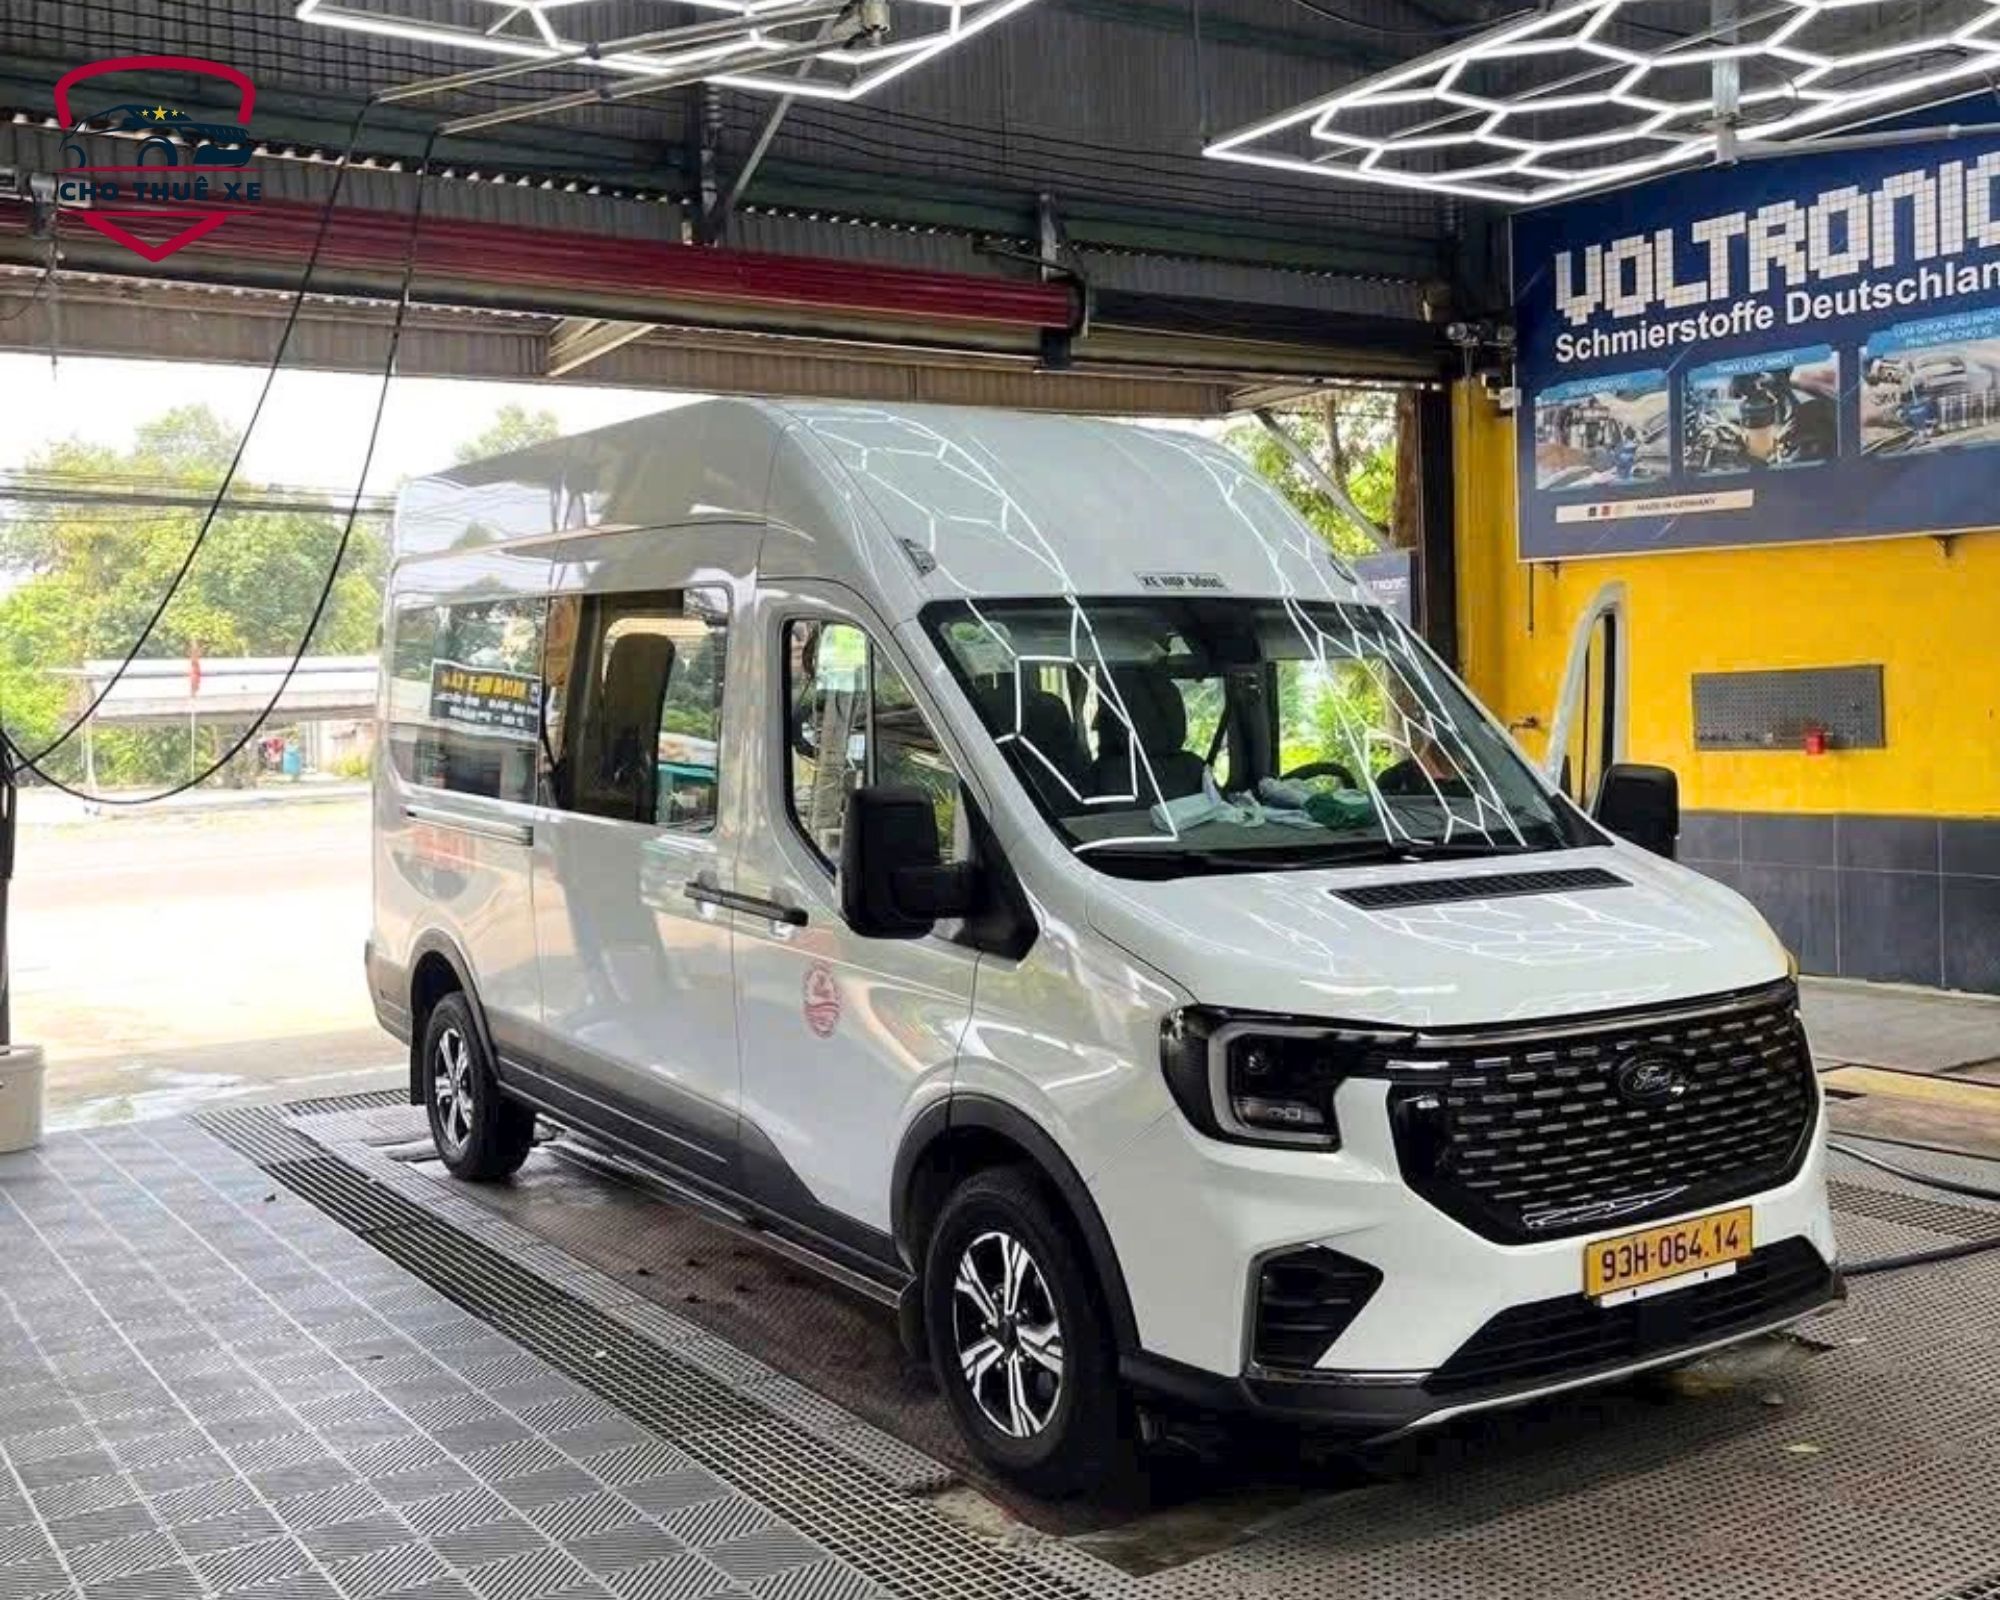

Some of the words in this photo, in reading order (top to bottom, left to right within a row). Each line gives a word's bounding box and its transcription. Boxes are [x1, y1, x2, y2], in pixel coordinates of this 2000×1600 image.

[1556, 300, 1774, 364] Schmierstoffe
[1633, 1064, 1672, 1090] Ford
[1602, 1219, 1739, 1282] 93H-064.14
